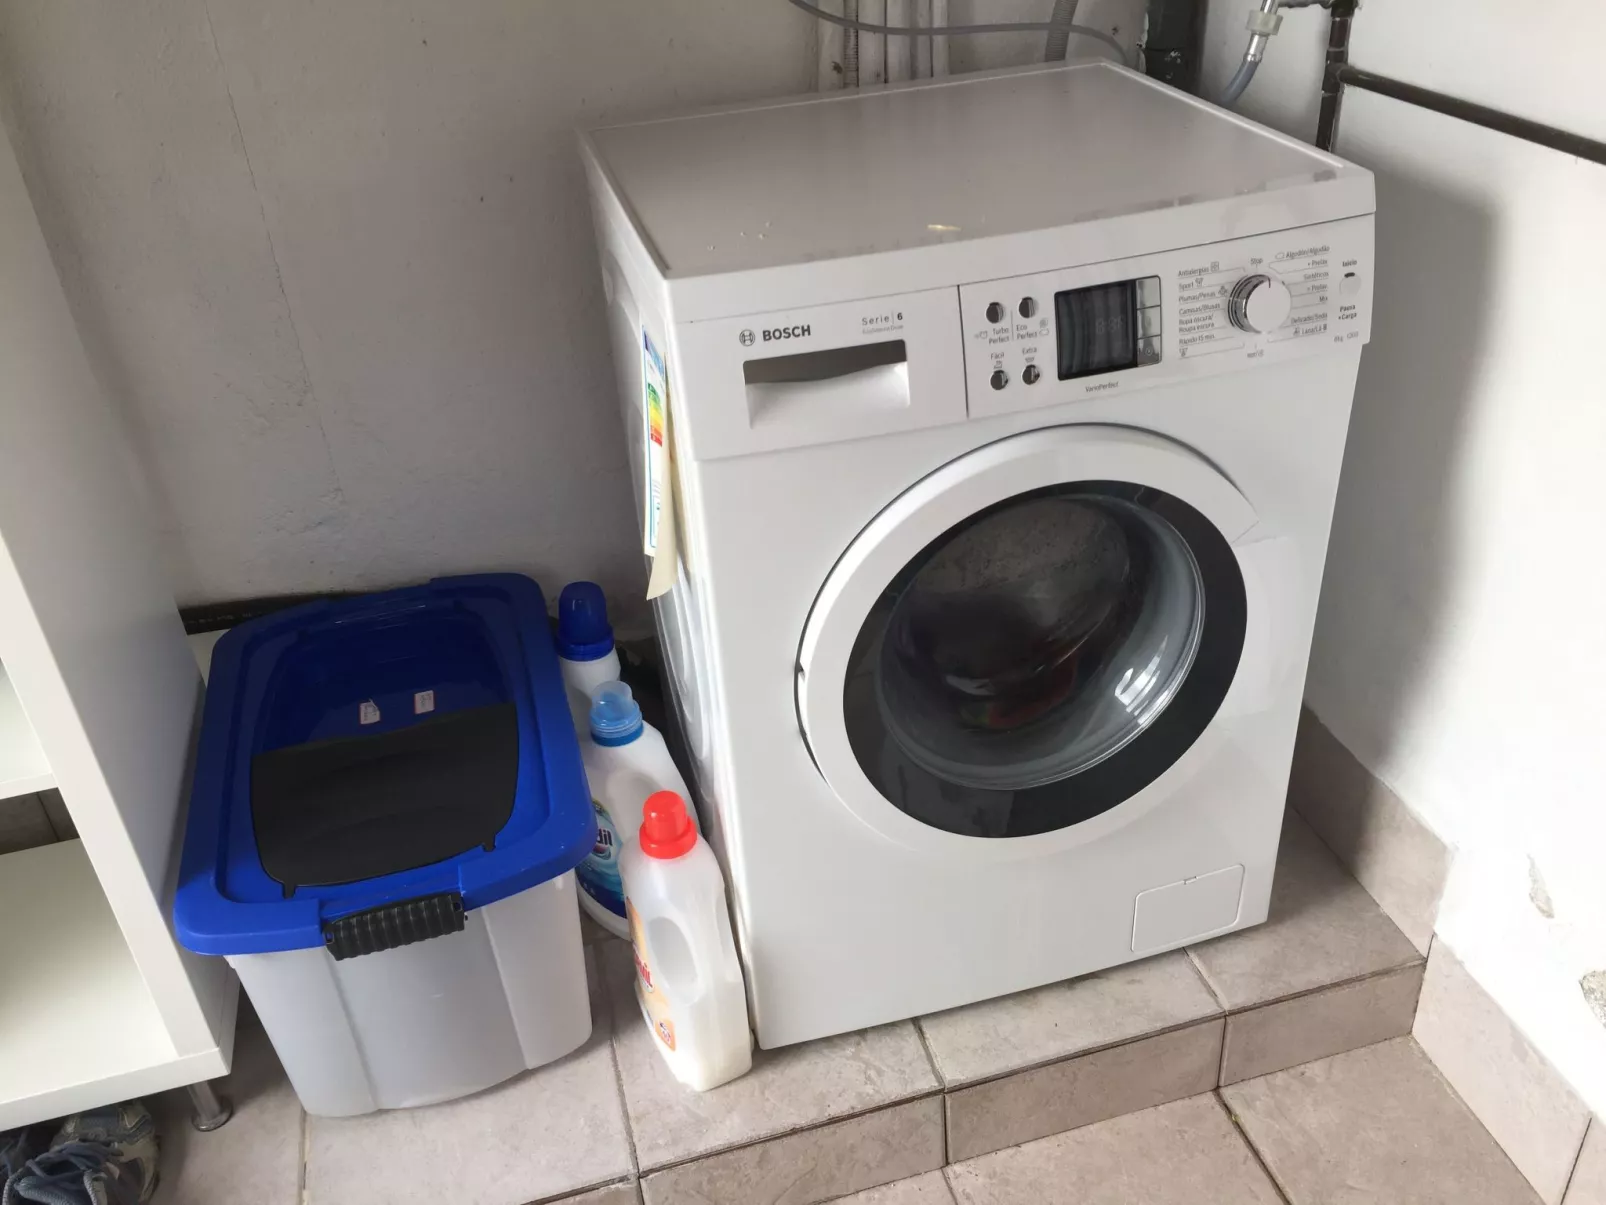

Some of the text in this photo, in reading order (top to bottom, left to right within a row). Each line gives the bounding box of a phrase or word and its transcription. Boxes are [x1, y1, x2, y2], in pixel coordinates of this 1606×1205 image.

[861, 312, 904, 326] Serie 6
[1016, 323, 1028, 332] Eco
[762, 324, 812, 342] BOSCH
[1016, 331, 1038, 341] Perfect
[988, 336, 1010, 346] Perfect
